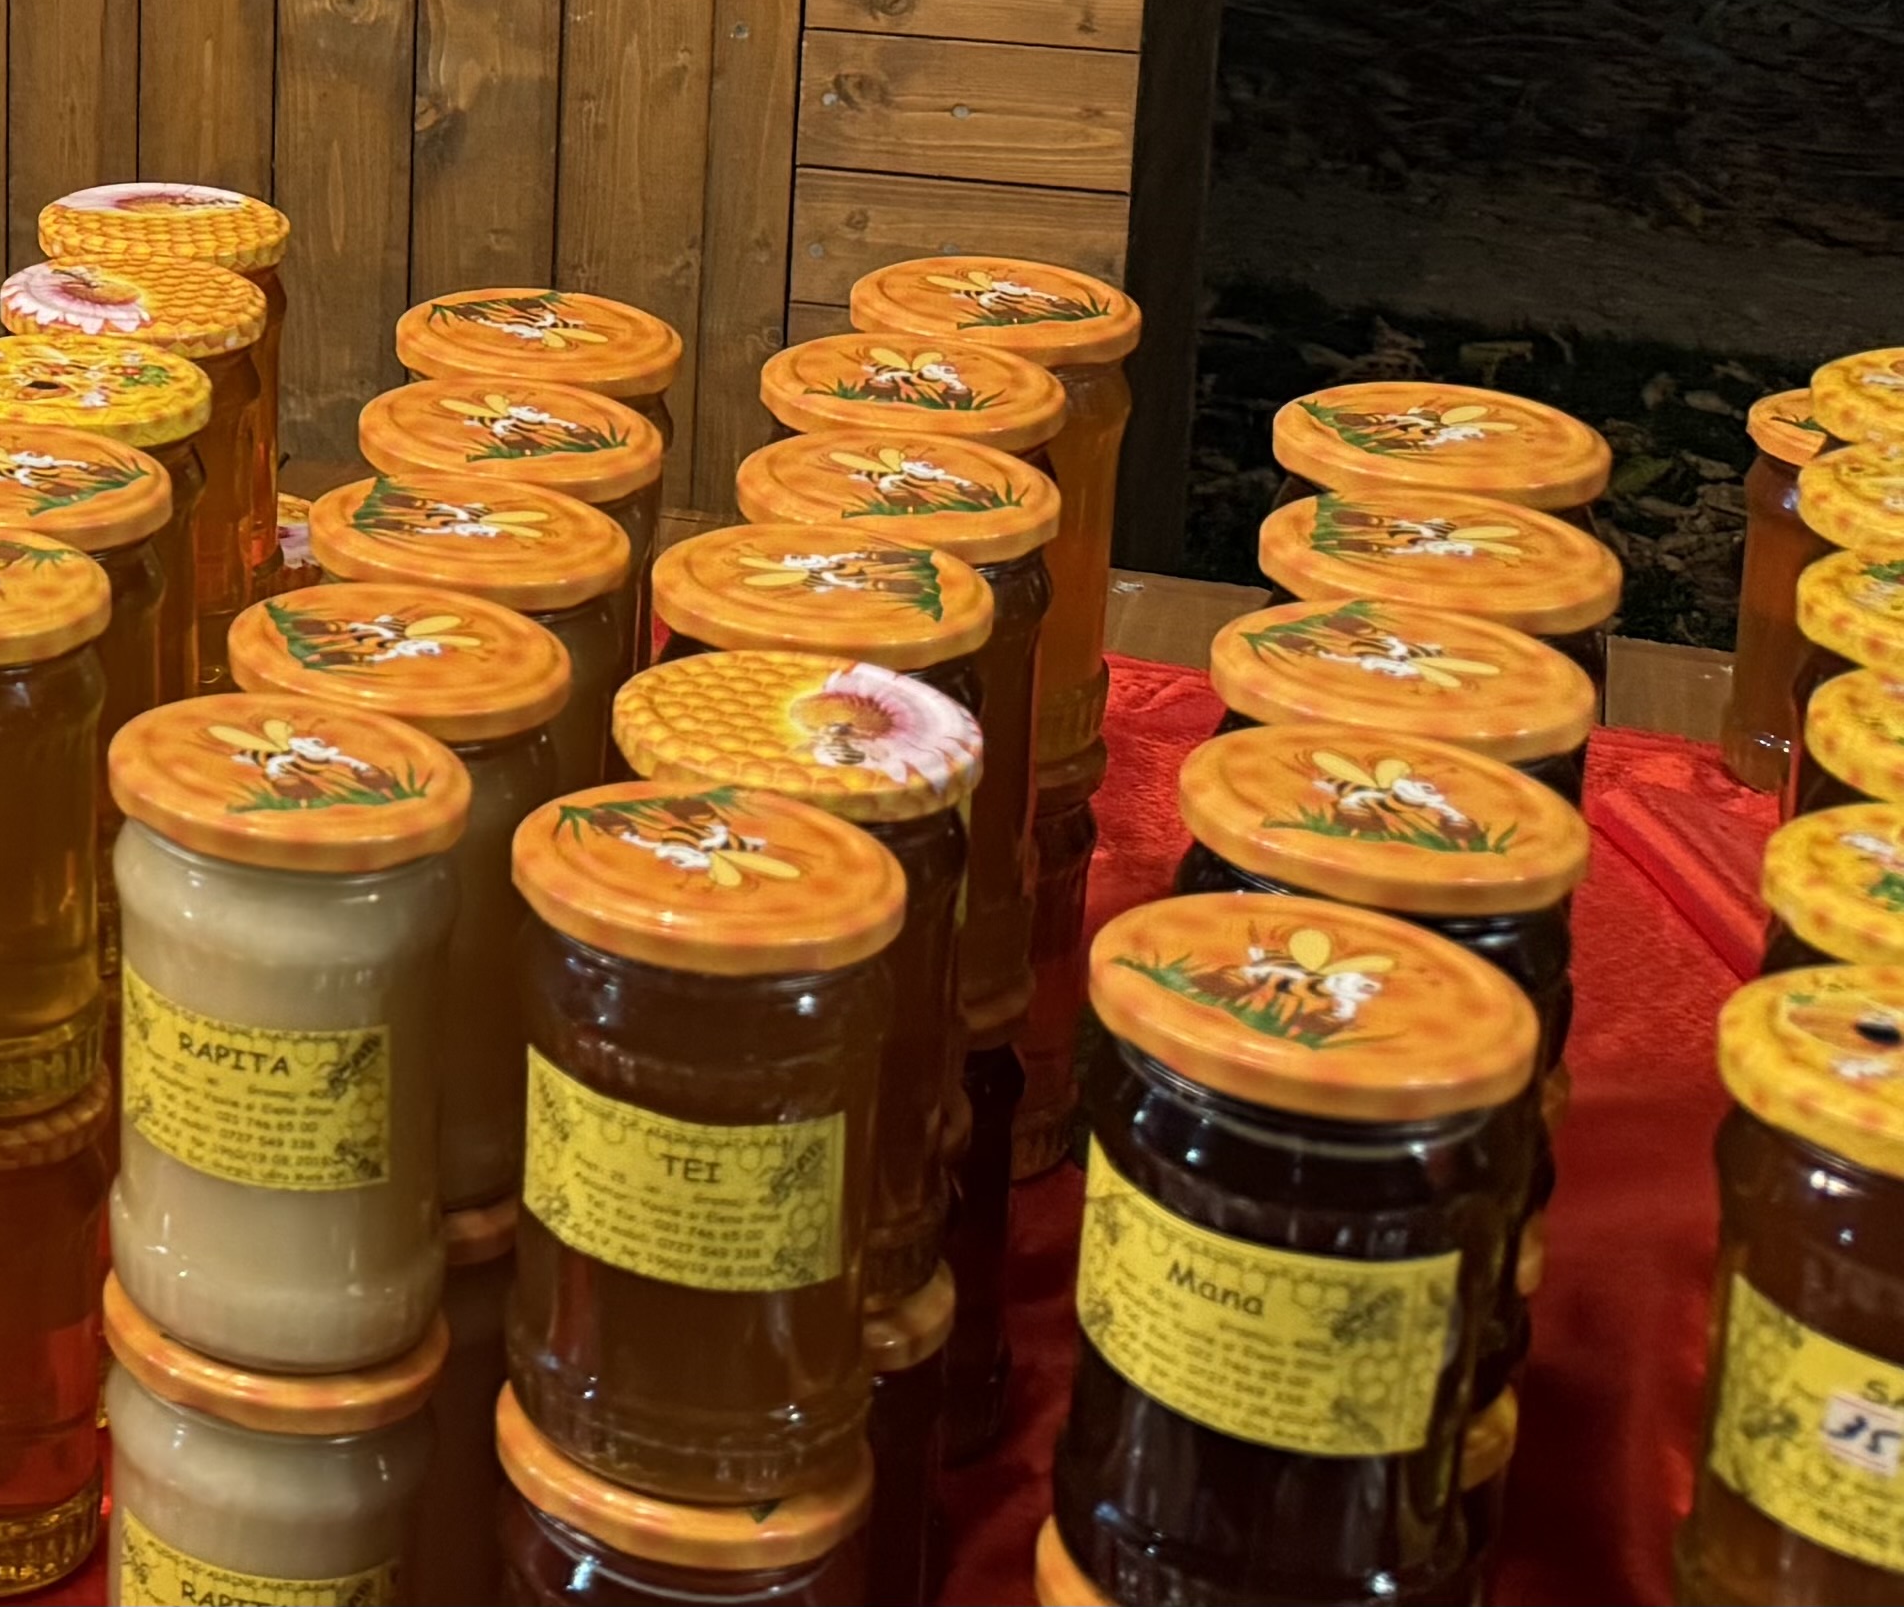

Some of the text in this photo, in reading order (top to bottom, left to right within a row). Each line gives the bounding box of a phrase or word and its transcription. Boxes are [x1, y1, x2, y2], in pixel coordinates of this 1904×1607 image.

[179, 1031, 290, 1077] RAPITA
[659, 1153, 722, 1184] TEI
[1167, 1259, 1265, 1317] Mana
